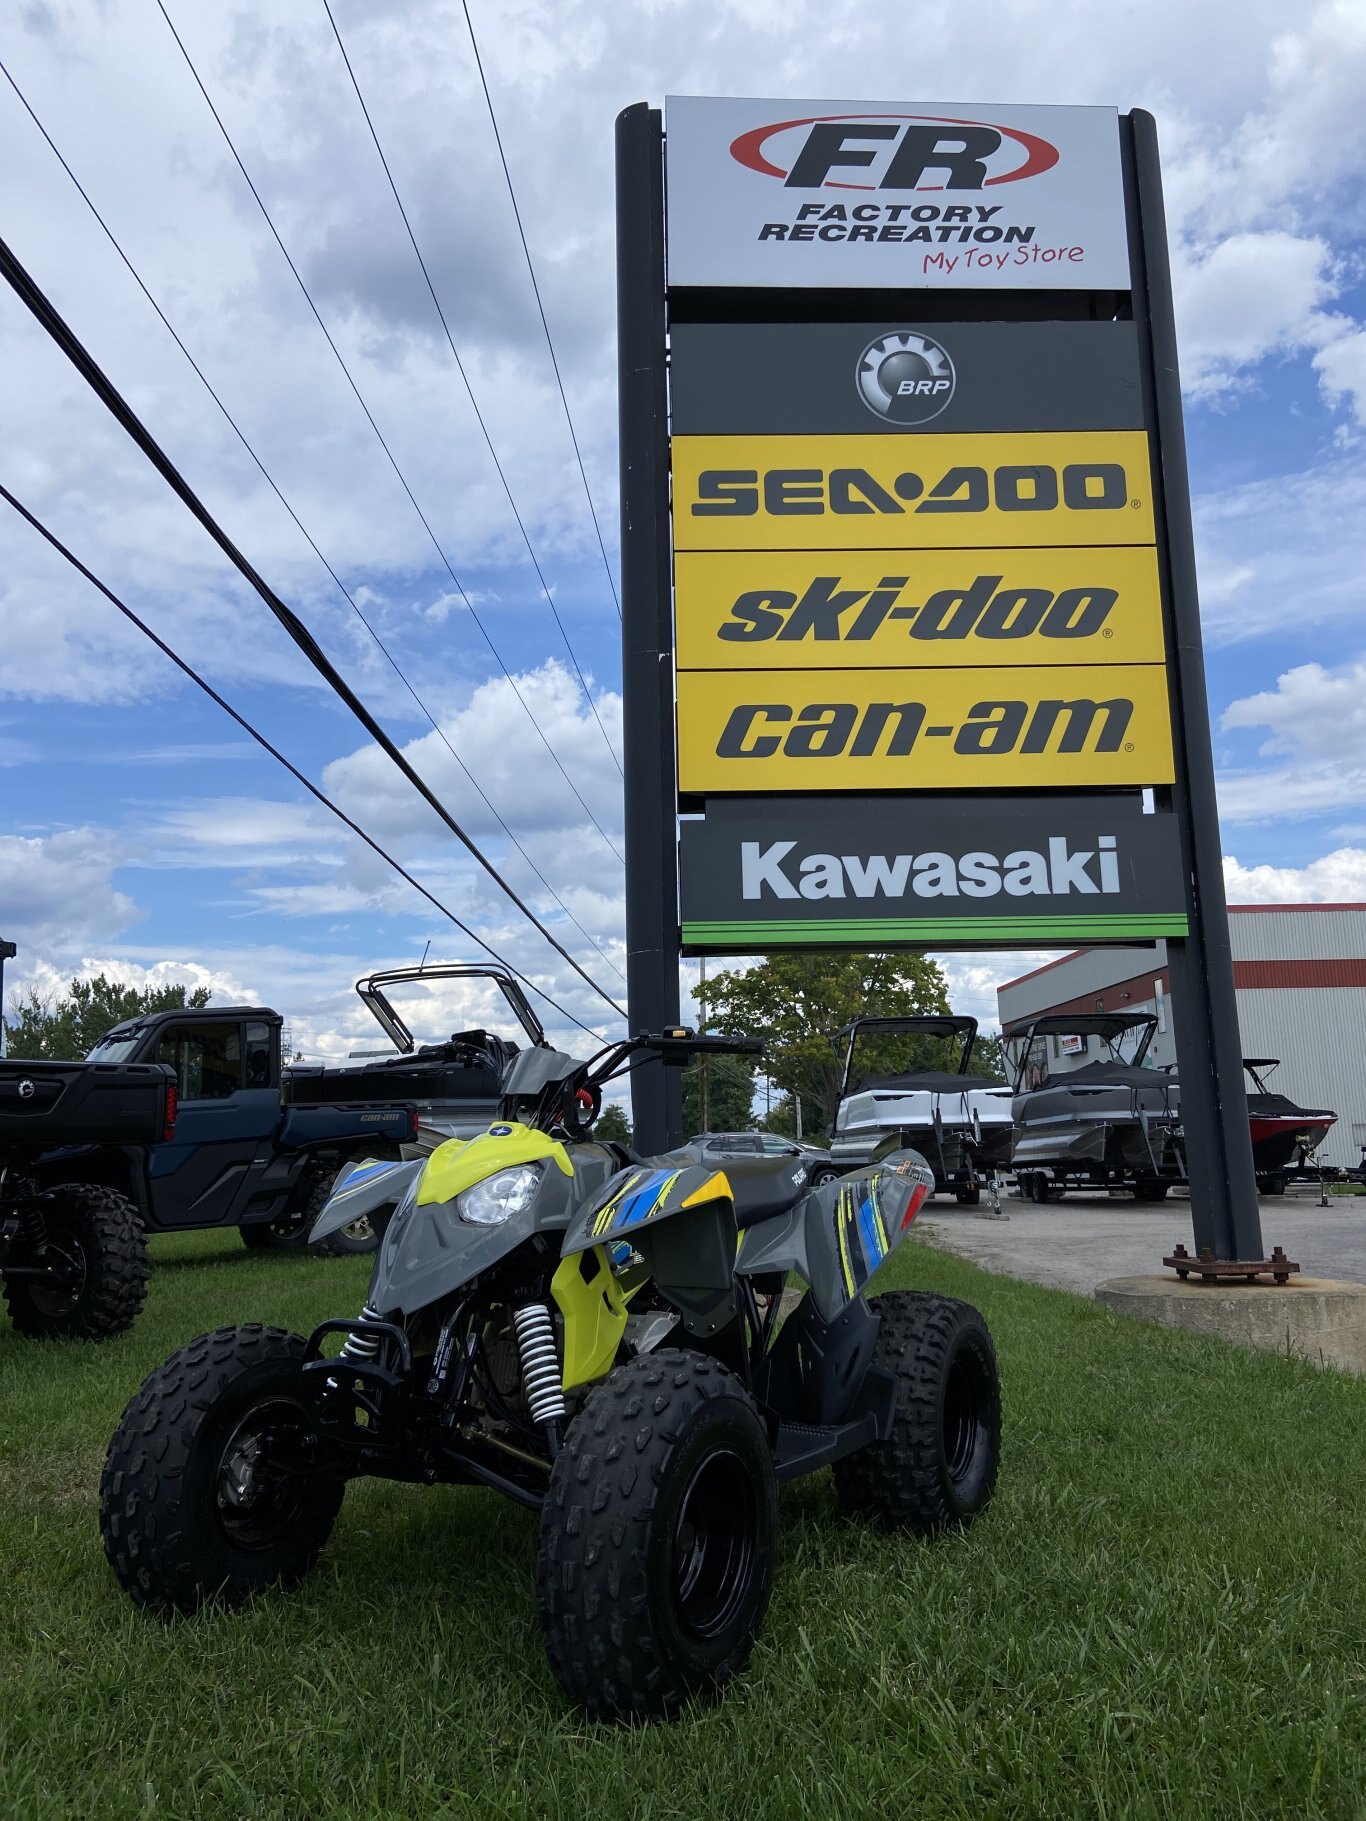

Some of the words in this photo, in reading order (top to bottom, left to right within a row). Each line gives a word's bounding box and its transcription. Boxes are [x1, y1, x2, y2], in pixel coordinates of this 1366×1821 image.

[783, 122, 1002, 190] FR
[795, 203, 1004, 224] FACTORY
[757, 223, 1036, 244] RECREATION
[922, 252, 960, 275] My
[963, 247, 1011, 271] Toy
[1013, 243, 1085, 266] Store
[896, 379, 951, 397] BRP
[716, 575, 1120, 643] ski-doo
[715, 698, 1135, 759] can-am
[740, 834, 1121, 900] Kawasaki
[360, 1113, 400, 1122] can-am
